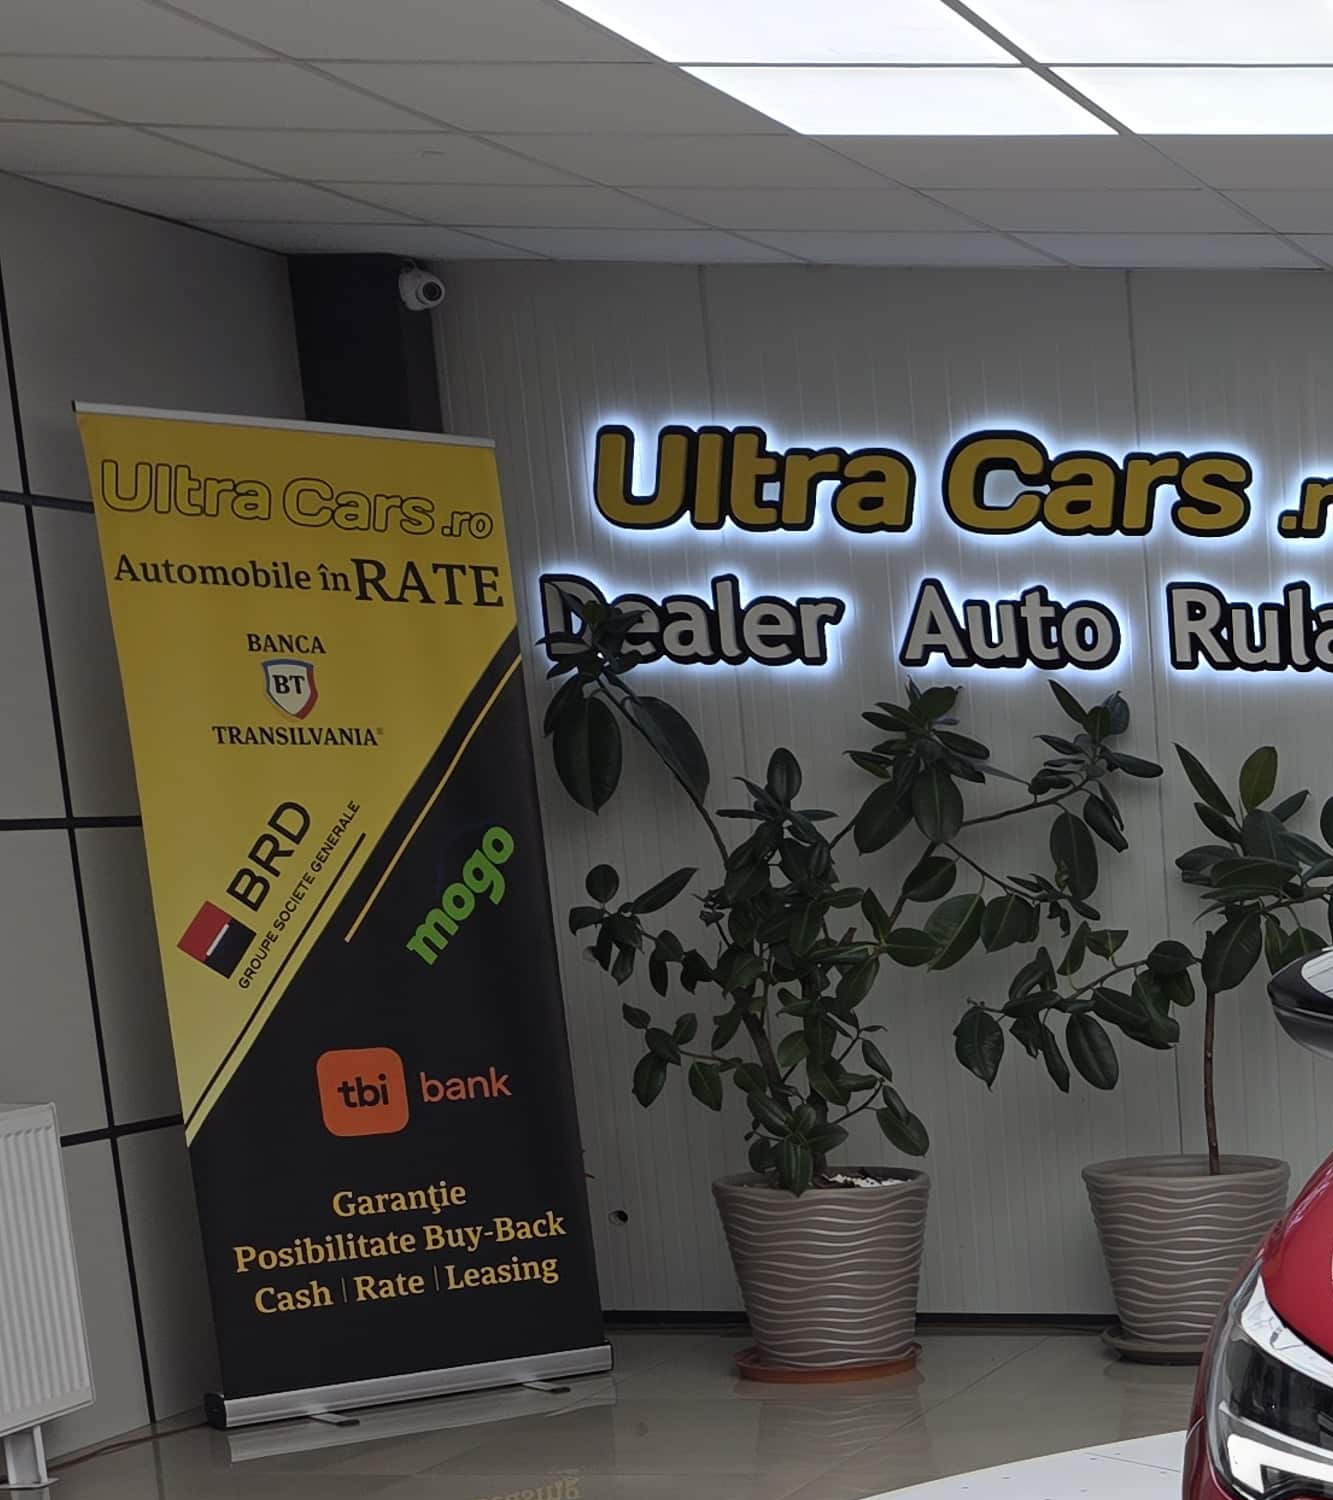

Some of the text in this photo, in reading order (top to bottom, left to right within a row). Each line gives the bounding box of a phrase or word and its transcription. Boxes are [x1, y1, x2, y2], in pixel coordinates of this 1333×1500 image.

[101, 460, 493, 539] Ultra Cars .ro
[593, 424, 916, 533] Ultra
[942, 430, 1252, 537] Cars
[114, 554, 504, 608] Automobile în RATE
[246, 633, 326, 654] BANCA
[899, 578, 1121, 670] Auto
[271, 674, 305, 695] BT
[226, 801, 312, 913] BRD
[238, 800, 361, 990] GROUPE SOCIETE GENERALE
[406, 825, 515, 966] mogo
[337, 1066, 512, 1108] tbi bank
[233, 1211, 567, 1274] Posibilitate Buy-Back
[254, 1280, 334, 1314] Cash
[353, 1272, 425, 1302] Rate
[446, 1256, 559, 1292] Leasing
